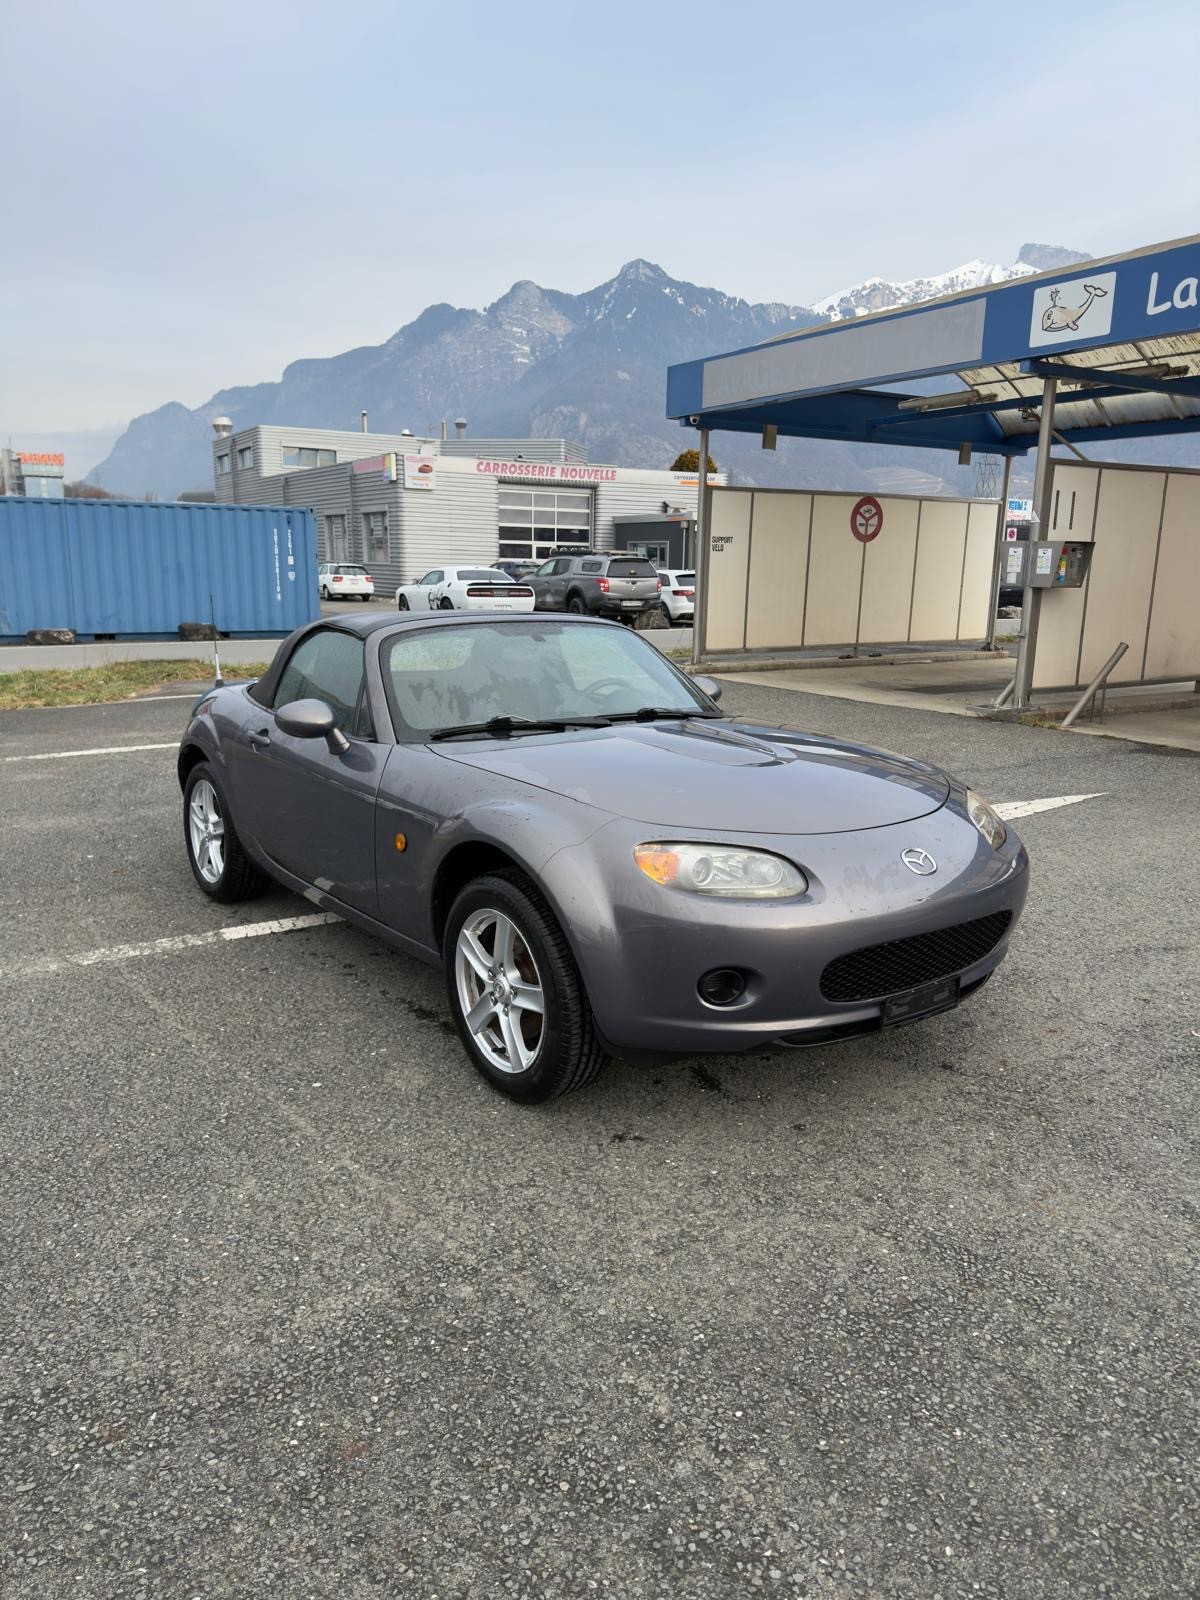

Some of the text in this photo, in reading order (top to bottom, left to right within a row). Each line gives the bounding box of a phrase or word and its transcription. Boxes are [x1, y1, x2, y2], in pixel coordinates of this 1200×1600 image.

[1146, 271, 1199, 316] La
[476, 461, 617, 481] CARROSSERIE NOUVELLE
[712, 536, 734, 544] SUPPORT
